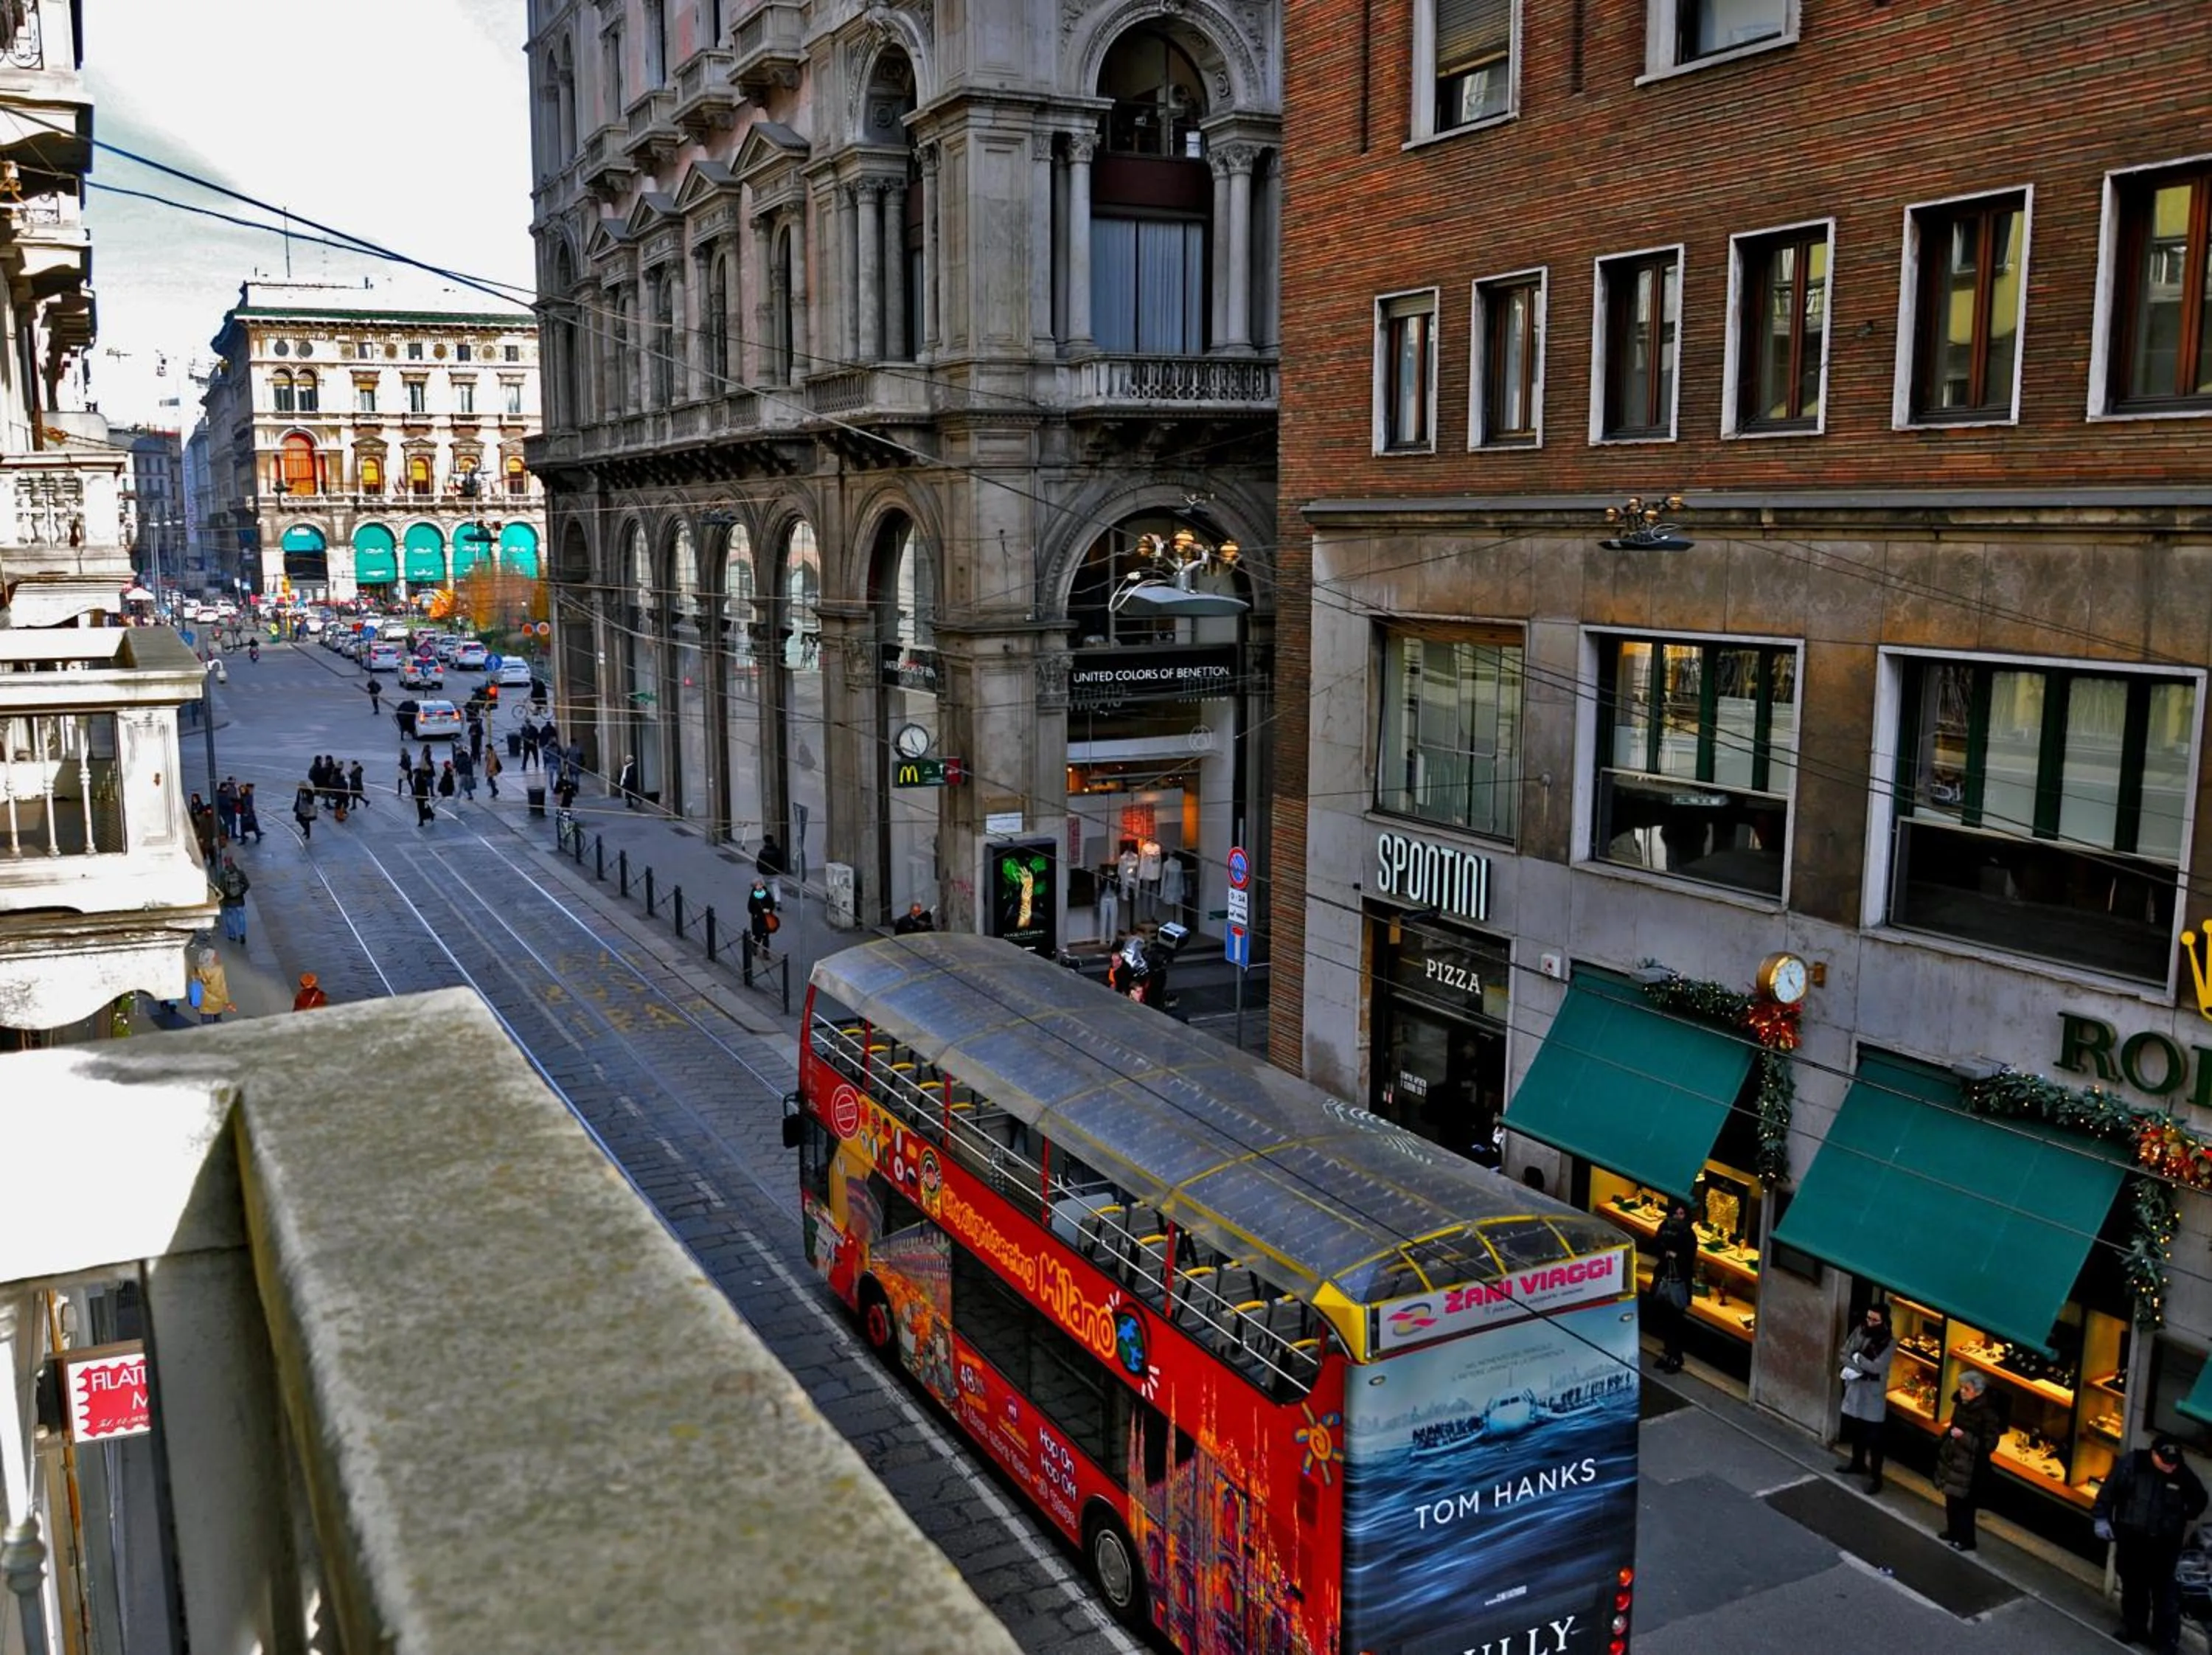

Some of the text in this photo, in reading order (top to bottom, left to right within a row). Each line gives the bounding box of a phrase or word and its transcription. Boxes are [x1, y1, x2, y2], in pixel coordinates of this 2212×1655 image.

[1074, 666, 1230, 683] UNITED COLORS OF BENETTON
[1377, 833, 1488, 921] SPONTINI
[1425, 958, 1481, 995] PIZZA
[1039, 1252, 1117, 1359] Milano
[1444, 1281, 1514, 1314] ZANI
[1519, 1256, 1614, 1295] VIAGGI
[1039, 1426, 1060, 1458] Hop
[1040, 1451, 1060, 1483] Hop
[1414, 1458, 1597, 1530] TOM HANKS
